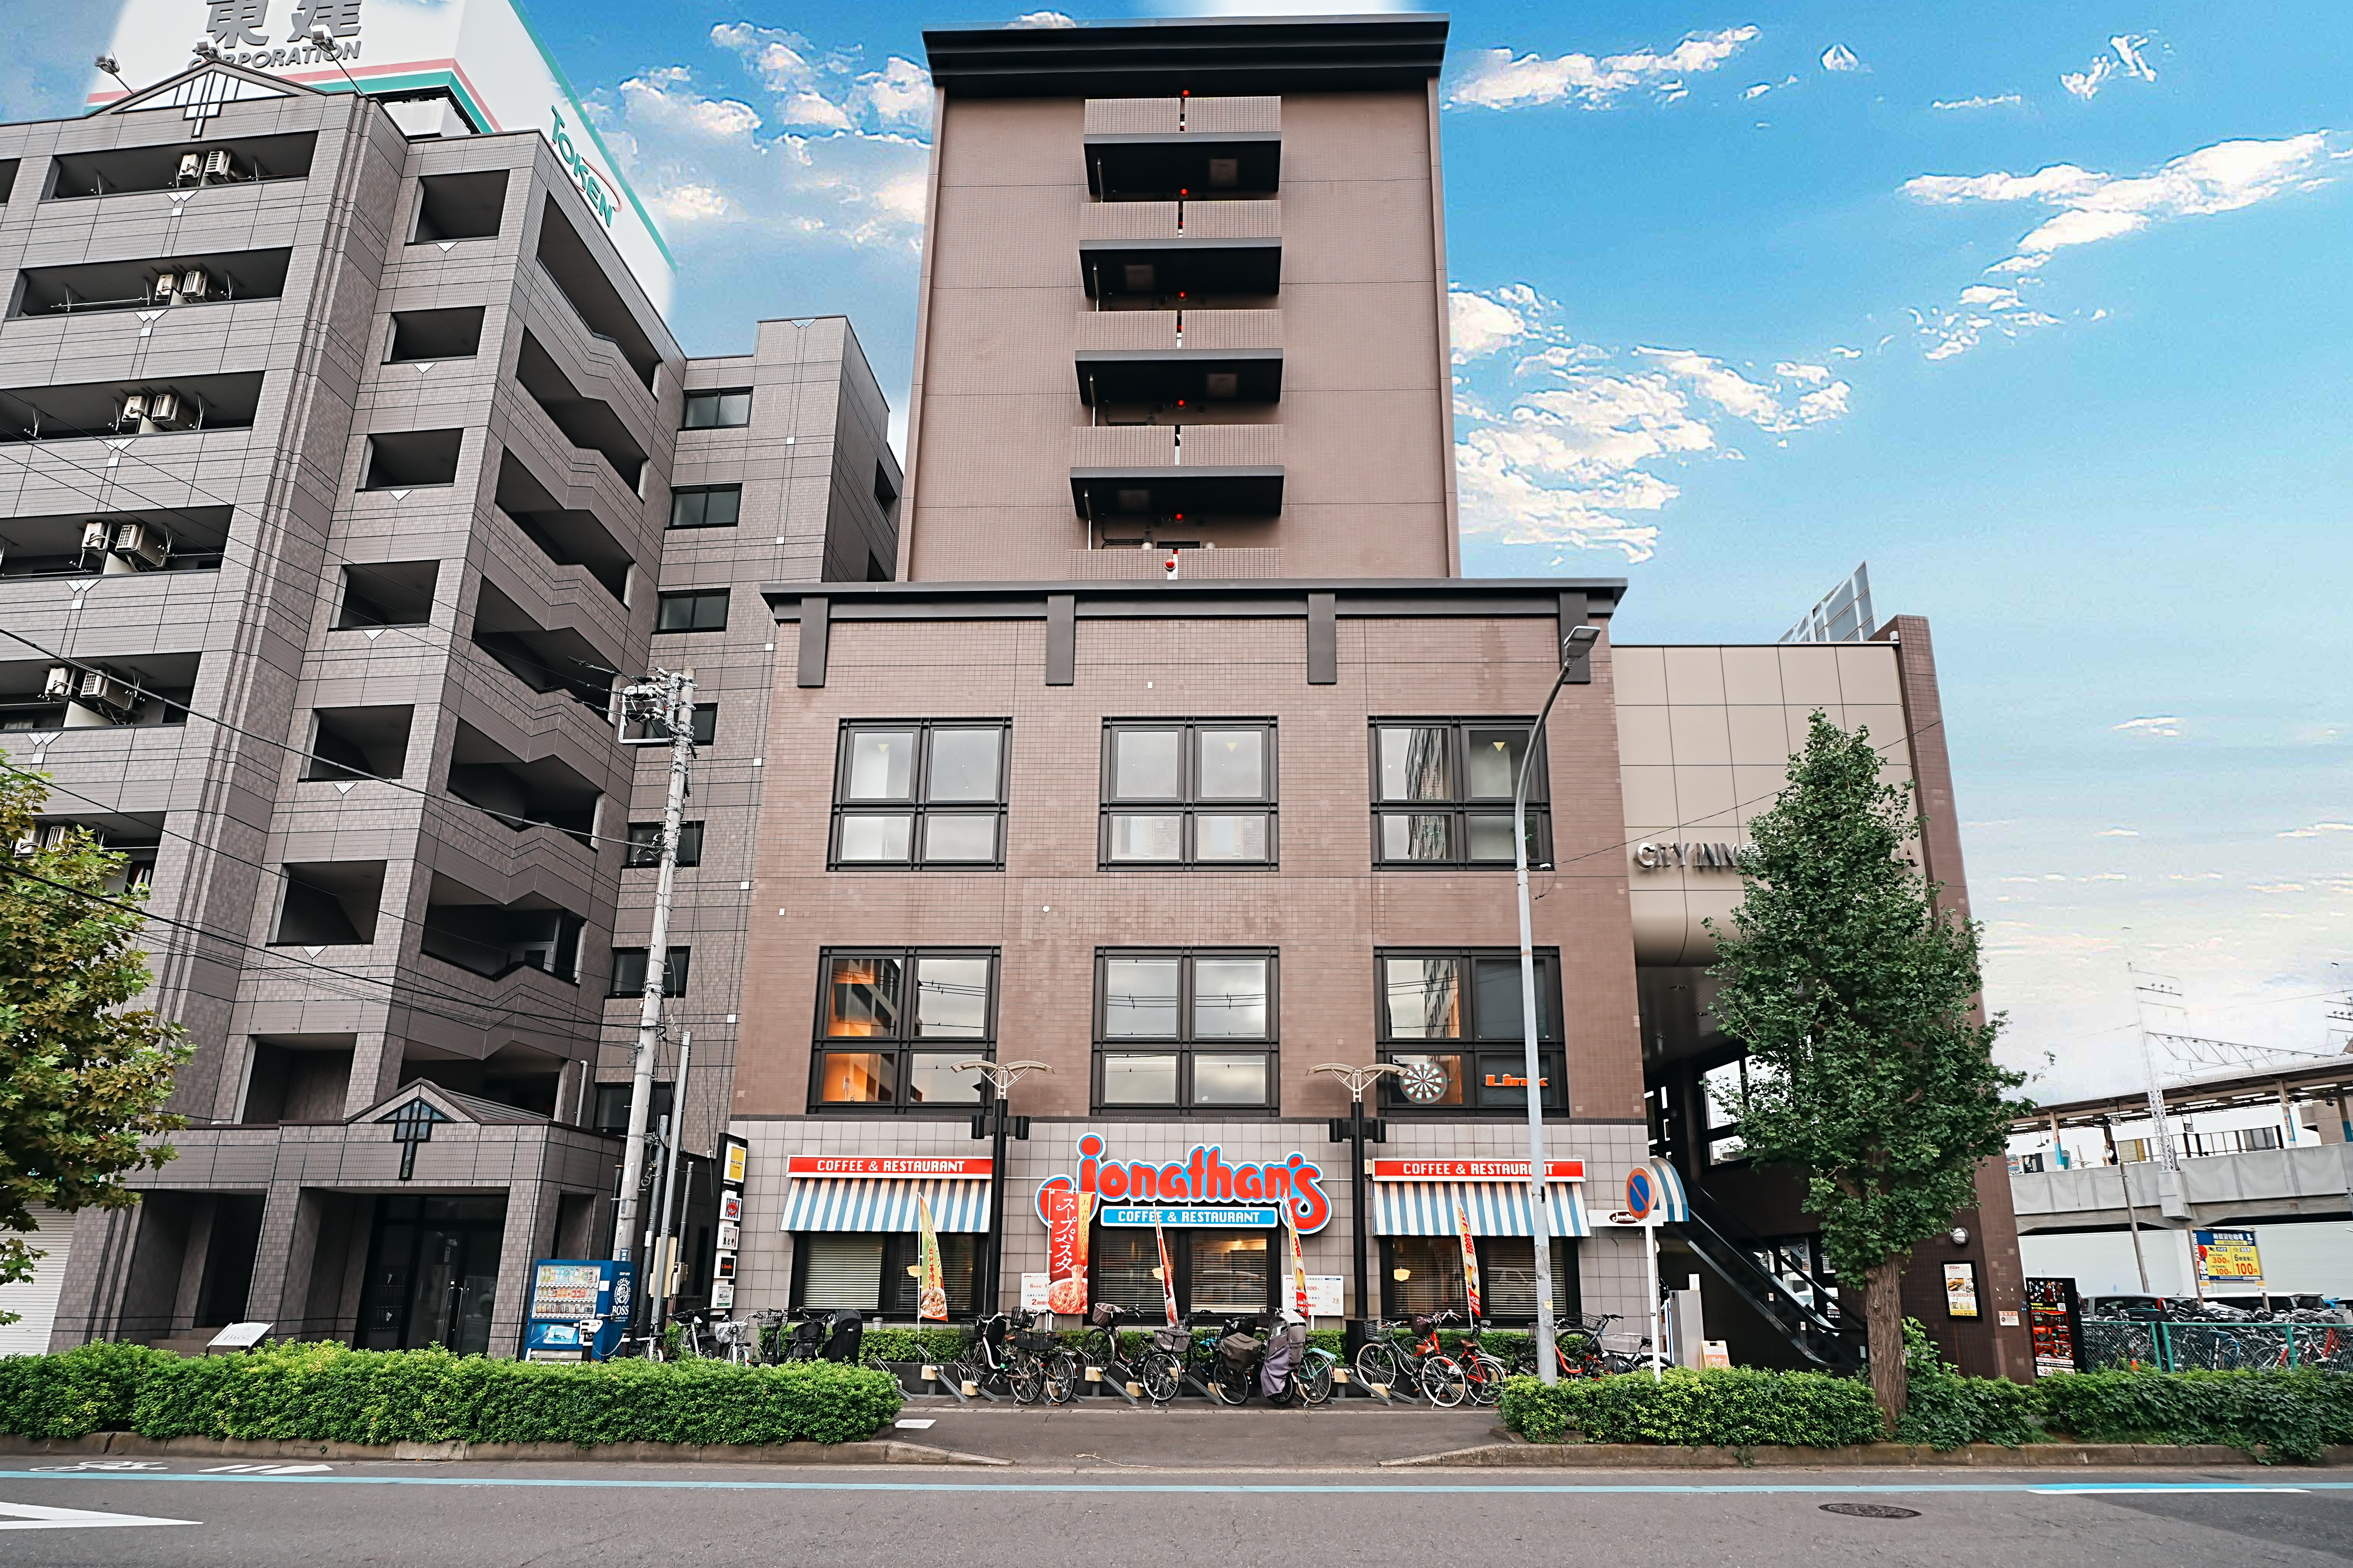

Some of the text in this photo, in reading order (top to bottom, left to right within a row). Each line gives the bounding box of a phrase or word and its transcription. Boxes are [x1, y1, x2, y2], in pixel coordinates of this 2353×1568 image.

[188, 41, 361, 70] CRPORATION
[551, 105, 613, 228] TOKEN
[817, 1159, 965, 1172] COFFEE & RESTAURANT
[1403, 1163, 1554, 1175] COFFEE & RESTAURT
[1118, 1211, 1260, 1223] COFFEE & RESTAURANT
[1052, 1198, 1078, 1273] スープパスタ
[1081, 1199, 1089, 1260] あふれんばかりの
[612, 1305, 629, 1315] BOSS
